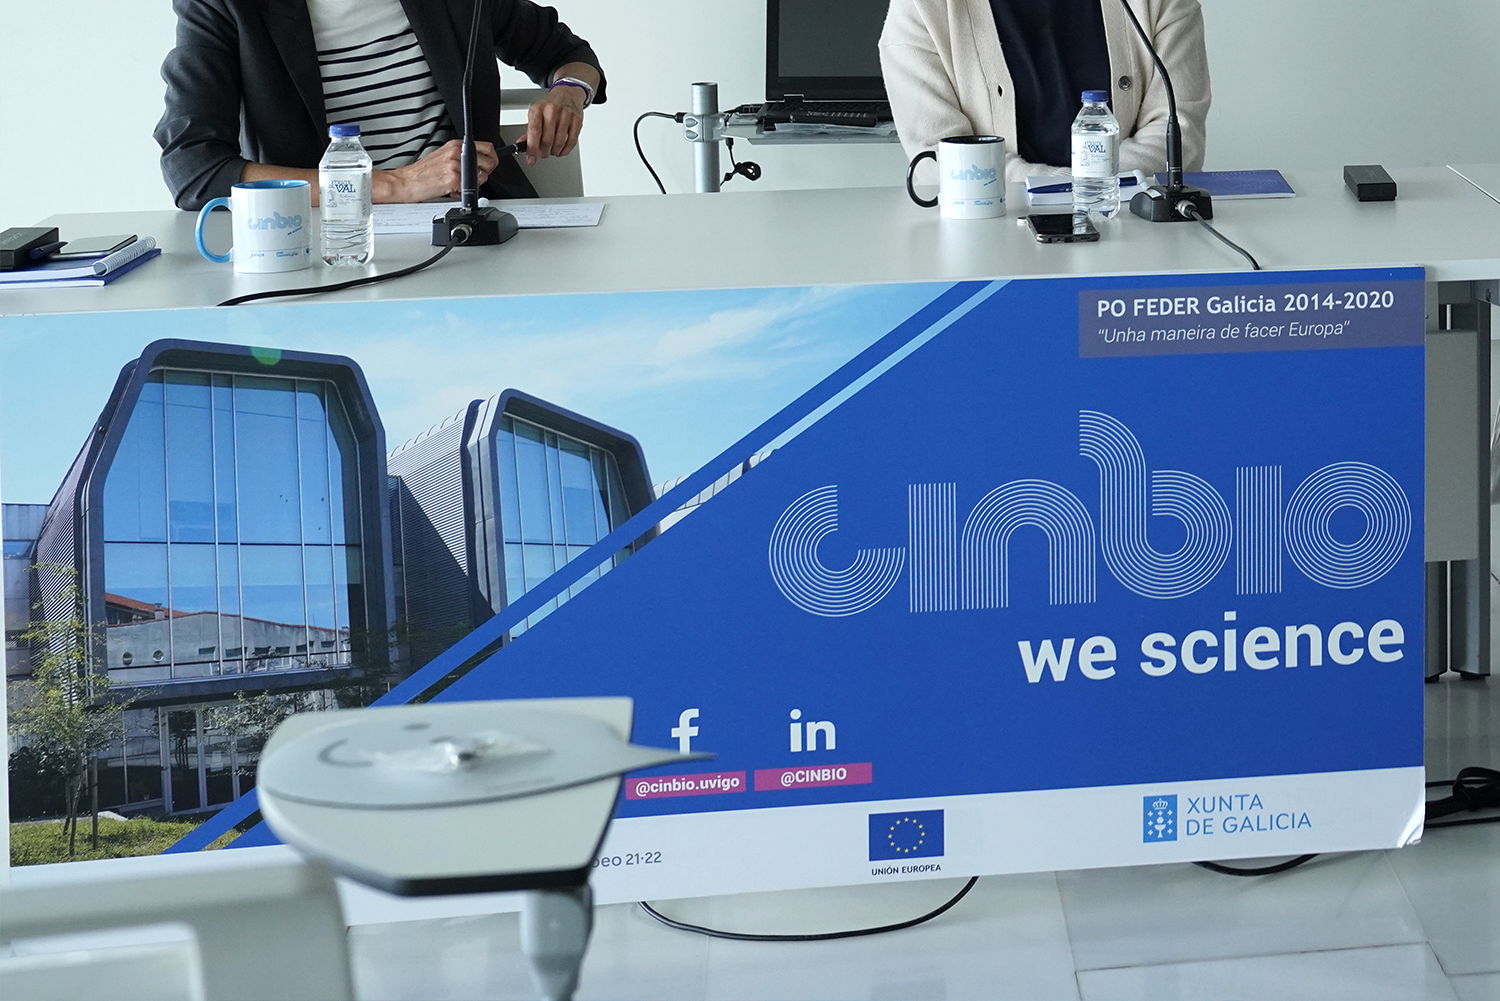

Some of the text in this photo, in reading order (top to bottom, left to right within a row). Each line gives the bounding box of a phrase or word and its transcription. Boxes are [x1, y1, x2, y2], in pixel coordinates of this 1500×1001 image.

[1098, 290, 1394, 317] PO FEDER Galicia 2014-2020
[1150, 325, 1215, 341] maneira
[1220, 321, 1240, 339] de
[1244, 320, 1285, 338] facer
[769, 410, 1411, 616] cinbio
[1018, 611, 1405, 683] we science
[790, 709, 836, 752] in
[635, 775, 740, 797] @cinbio.uvigo
[781, 767, 847, 787] @CINBIO
[1187, 793, 1264, 814] XUNTA
[1186, 812, 1312, 836] DE GALICIA
[871, 864, 941, 876] UNIÓN EUROPEA
